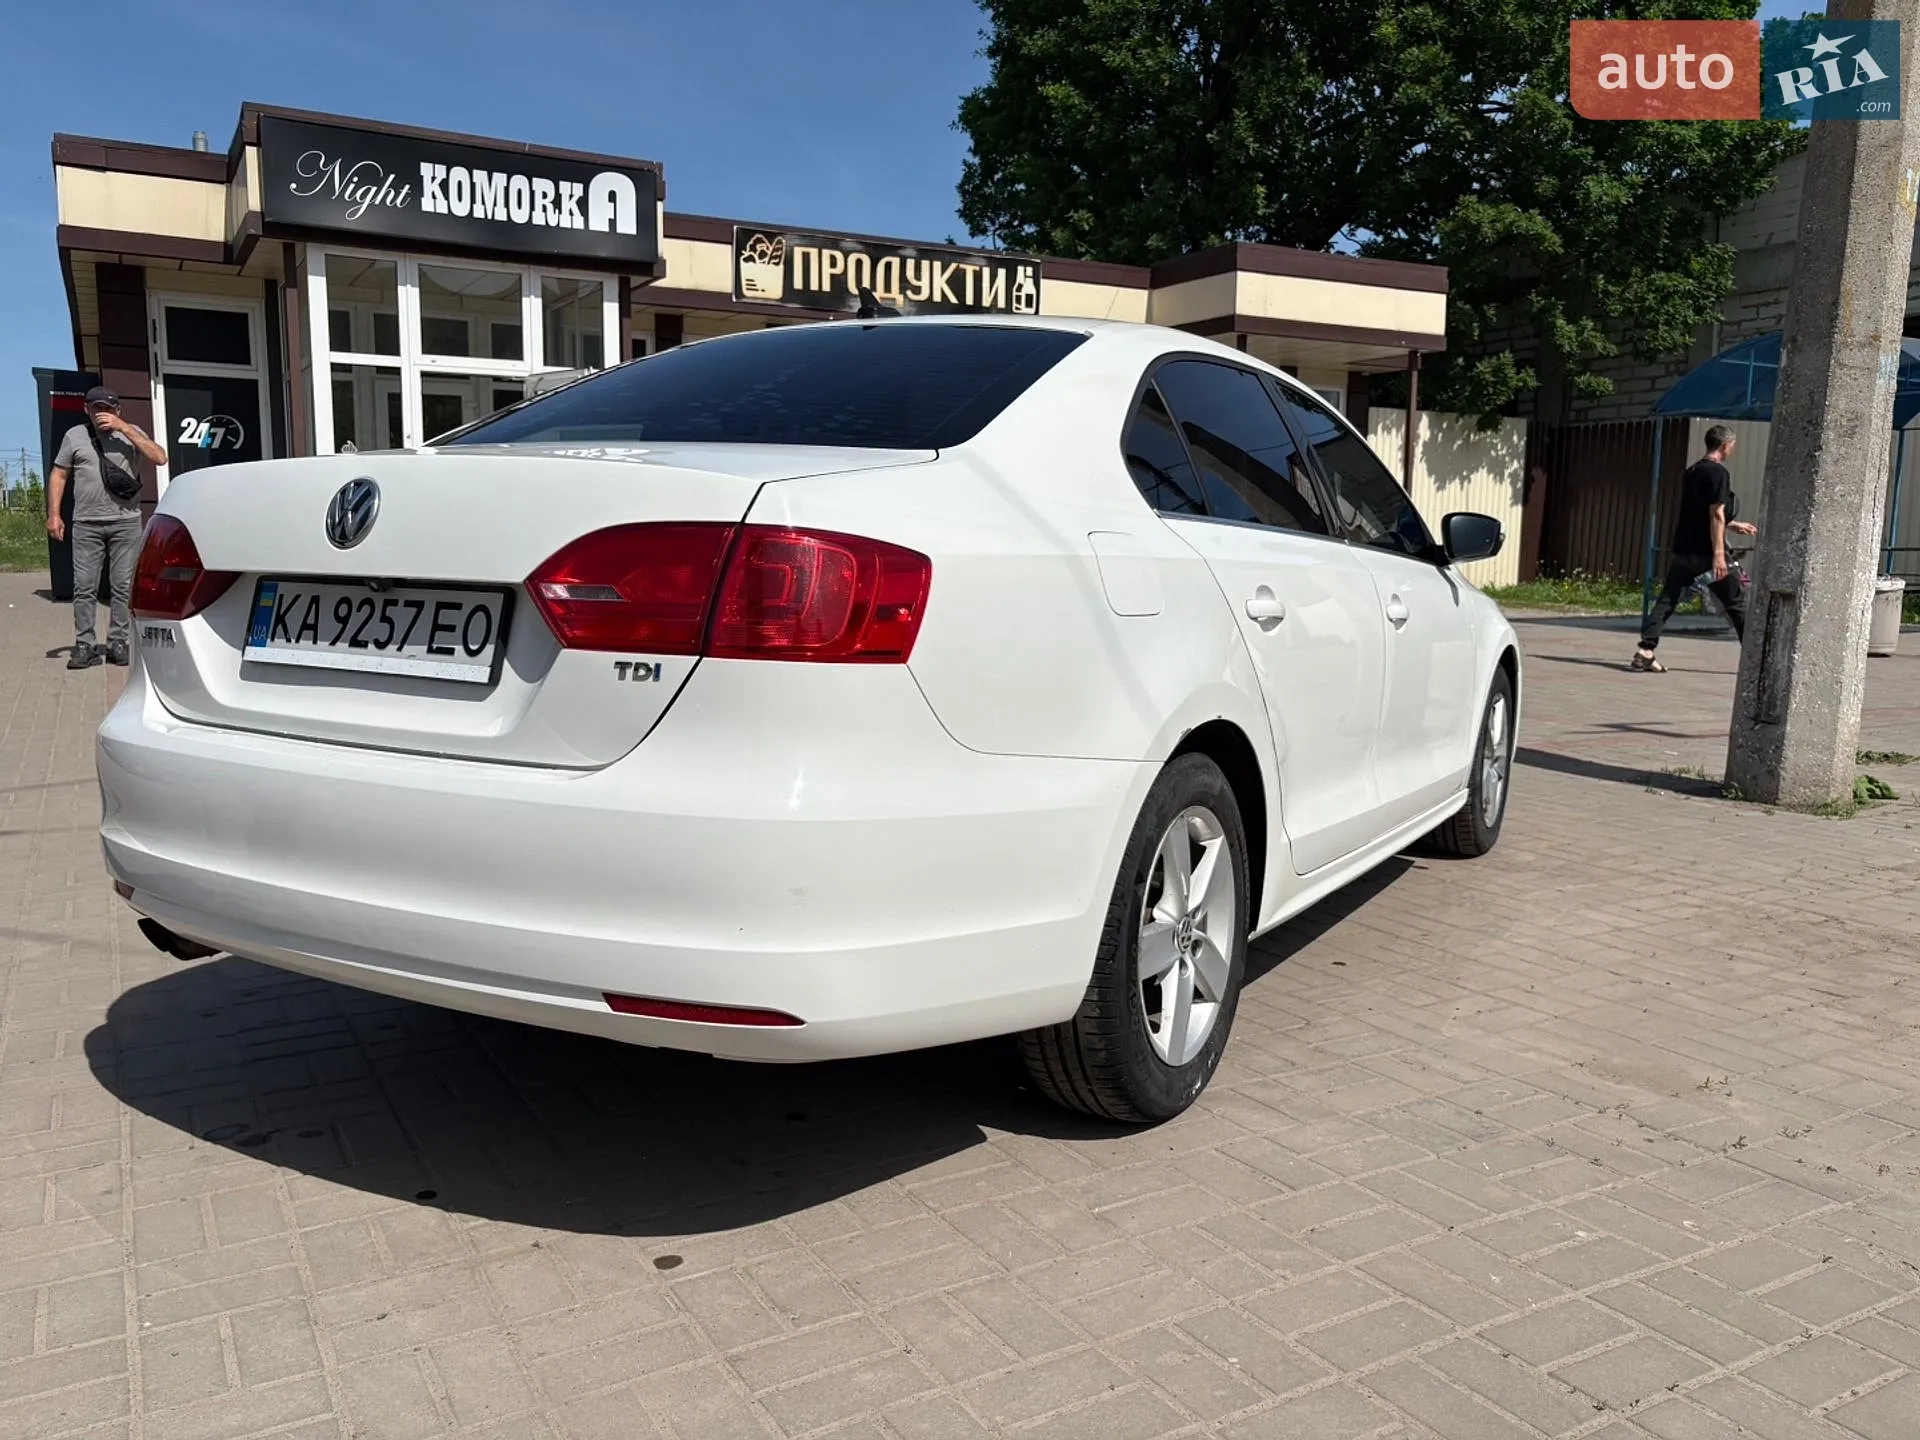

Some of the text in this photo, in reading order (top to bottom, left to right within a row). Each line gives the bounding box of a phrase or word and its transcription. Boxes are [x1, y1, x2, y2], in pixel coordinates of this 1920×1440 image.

[289, 150, 637, 235] Night KOMORKA
[793, 246, 1007, 309] ПРОДУКТИ
[141, 626, 176, 642] JETTA
[253, 625, 267, 639] UA
[270, 593, 493, 657] KA 9257 EO
[613, 661, 662, 682] TDI
